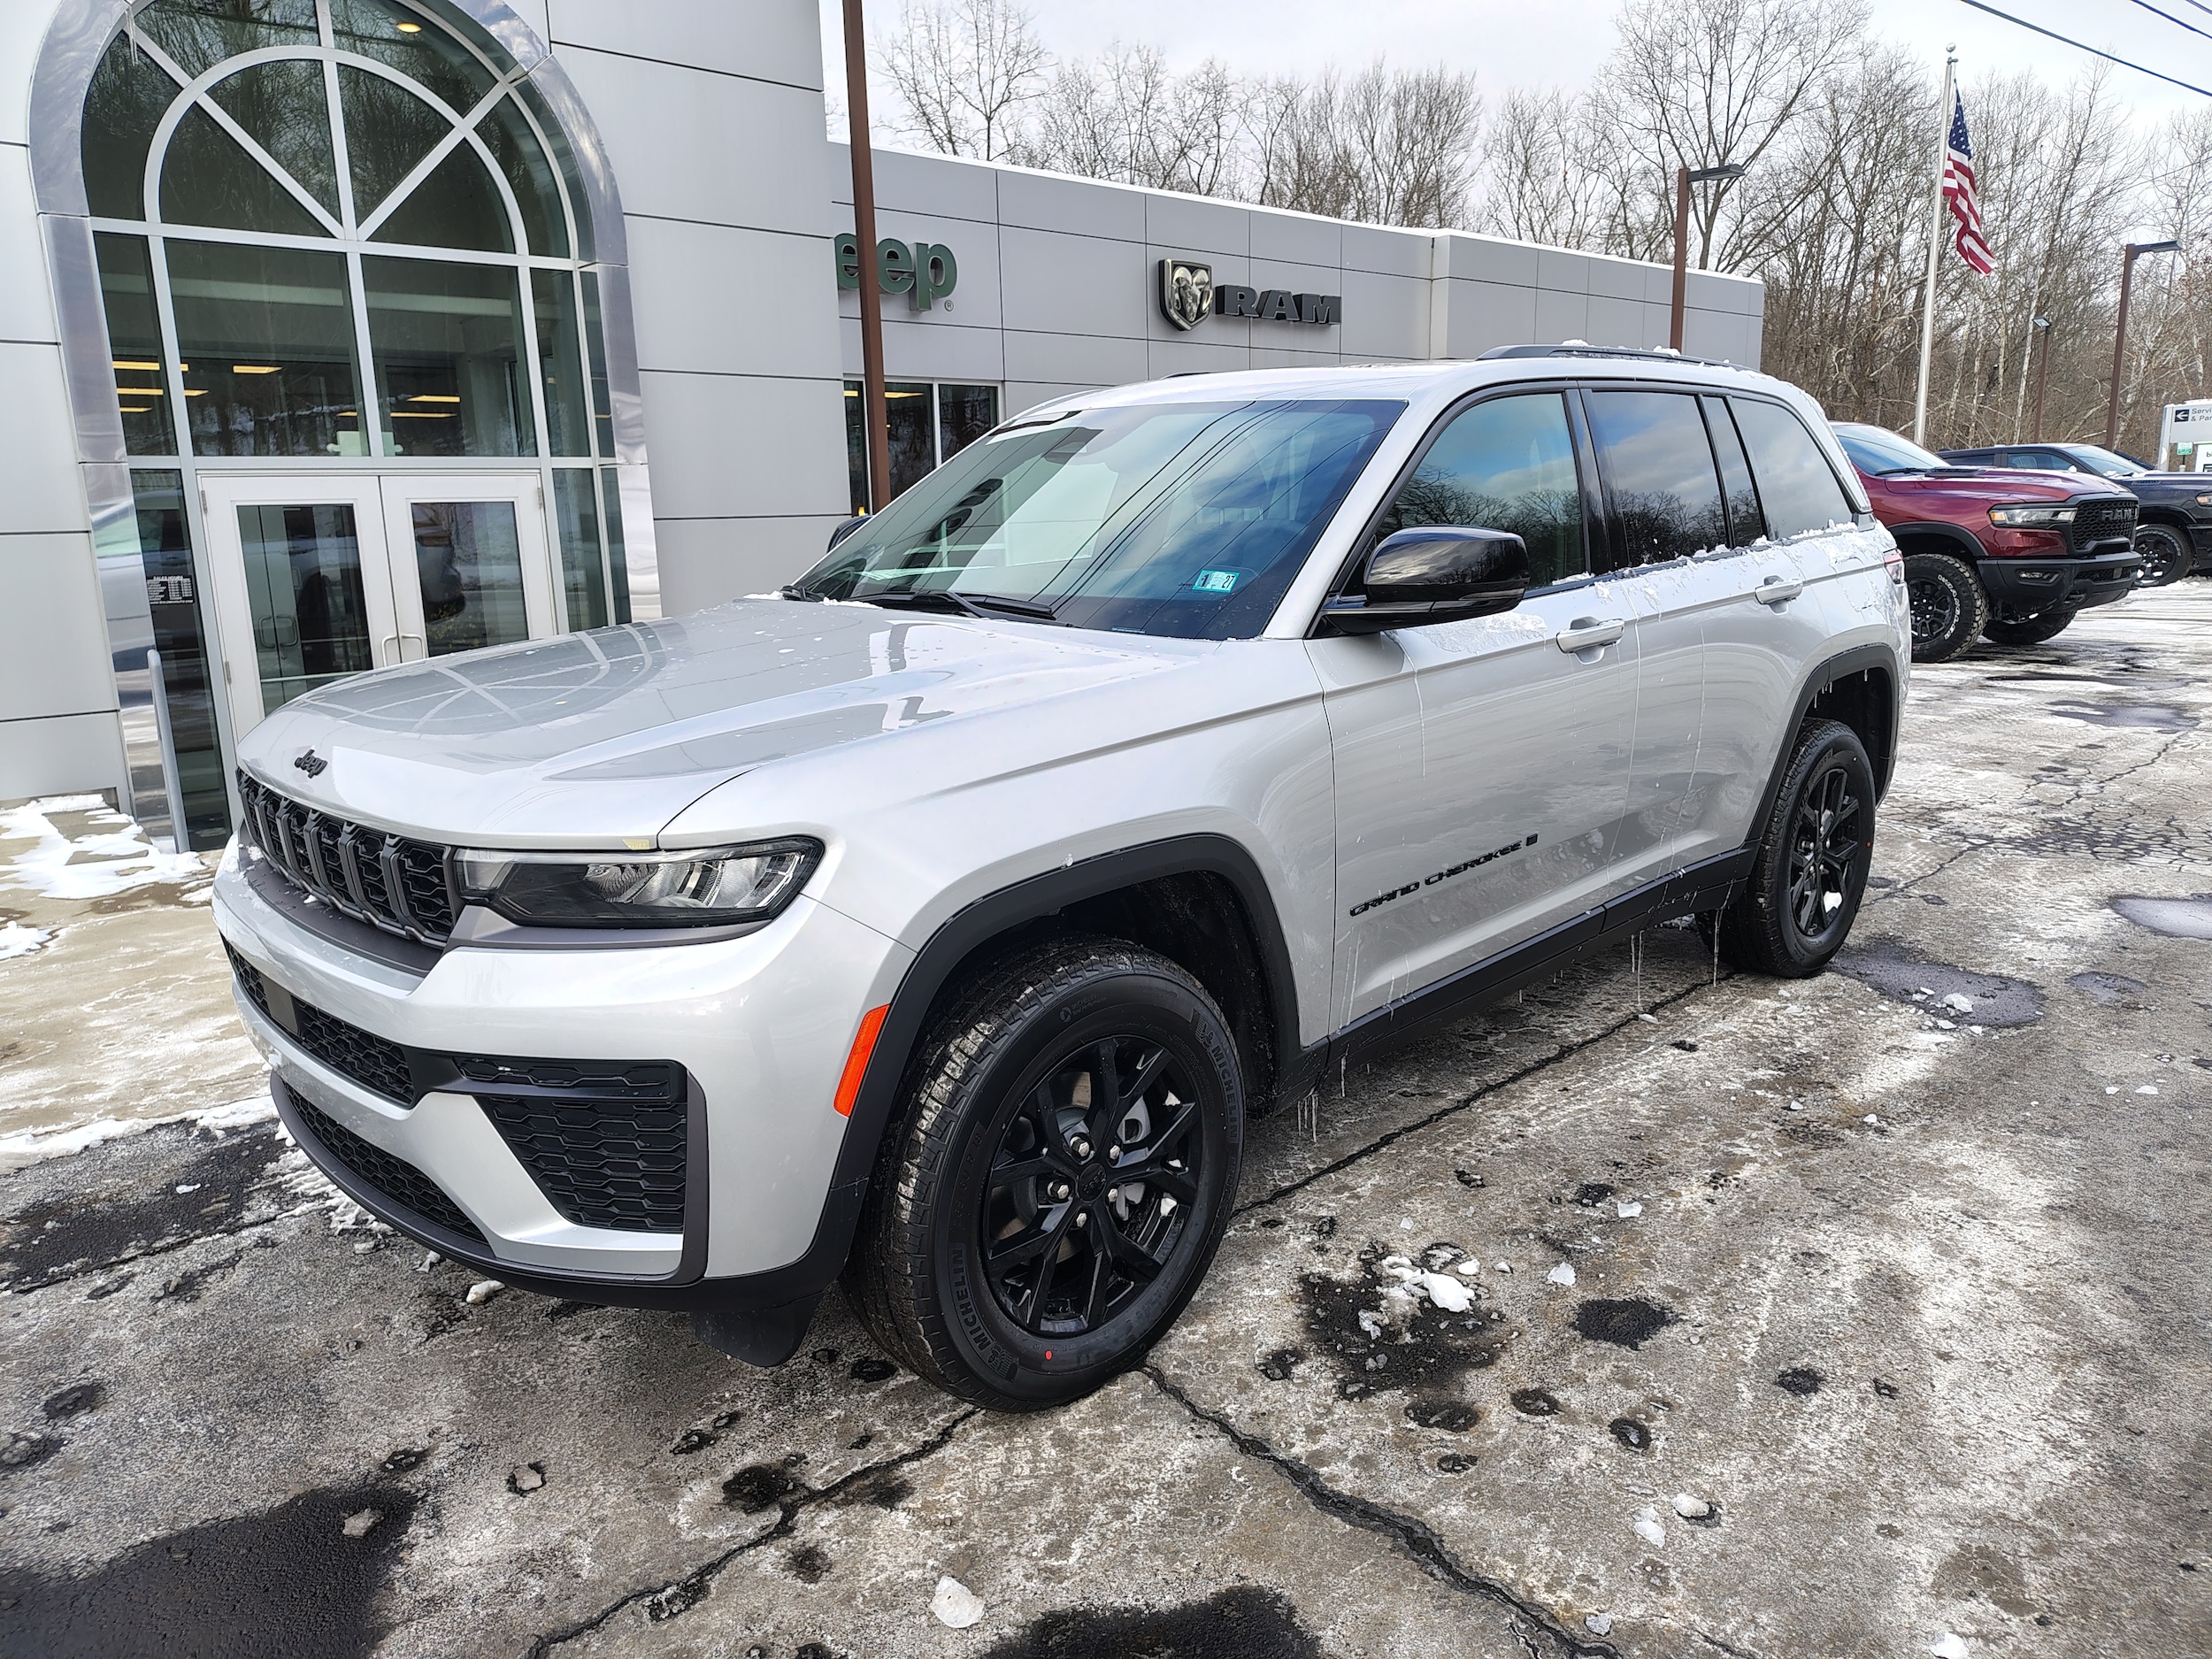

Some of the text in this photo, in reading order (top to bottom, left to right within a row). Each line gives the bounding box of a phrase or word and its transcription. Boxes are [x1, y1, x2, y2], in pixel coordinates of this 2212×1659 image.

[834, 233, 957, 311] eep
[1215, 284, 1342, 325] RAM
[2101, 508, 2133, 521] RAM
[1222, 575, 1235, 589] 27
[295, 749, 328, 779] Jeep
[1350, 841, 1523, 917] GRAND CHEROKEE
[1211, 1044, 1239, 1140] MICHELIN
[952, 1248, 992, 1351] MICHELIN
